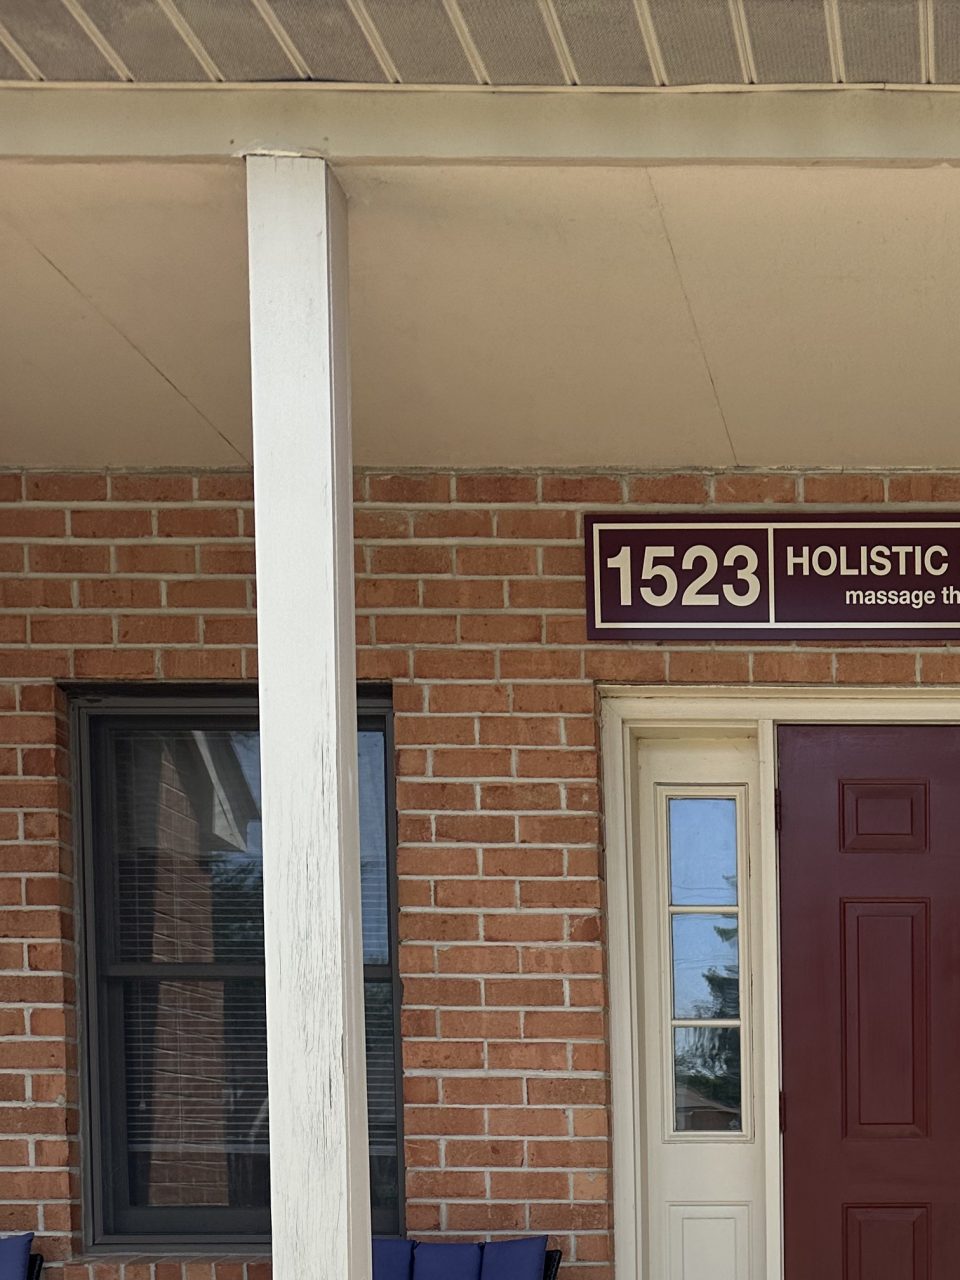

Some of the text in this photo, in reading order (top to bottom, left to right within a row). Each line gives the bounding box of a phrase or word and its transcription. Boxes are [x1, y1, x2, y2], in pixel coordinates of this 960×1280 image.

[606, 544, 761, 607] 1523
[786, 545, 949, 576] HOLISTIC
[845, 590, 936, 609] massage
